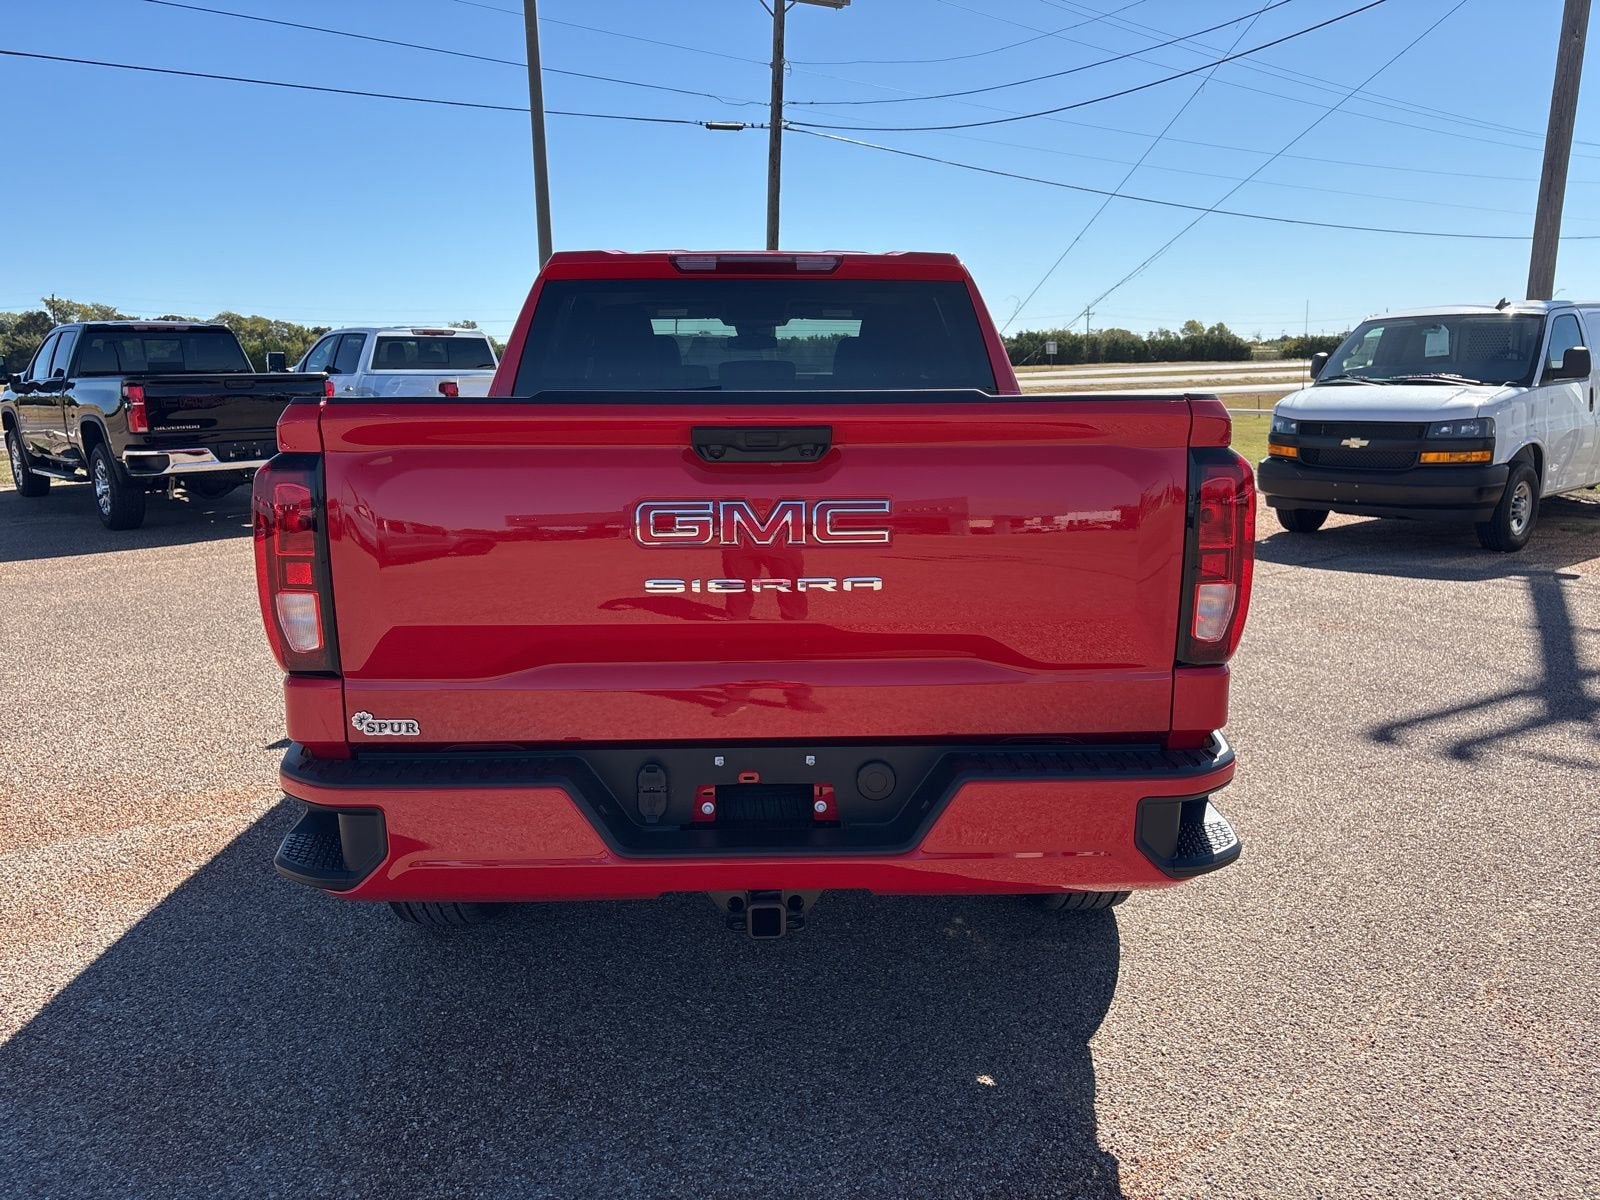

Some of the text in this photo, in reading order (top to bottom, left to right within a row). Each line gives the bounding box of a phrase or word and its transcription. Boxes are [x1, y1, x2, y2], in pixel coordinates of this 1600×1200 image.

[635, 499, 890, 546] GMC
[644, 576, 883, 593] SIERRA
[366, 722, 417, 733] SPUR
